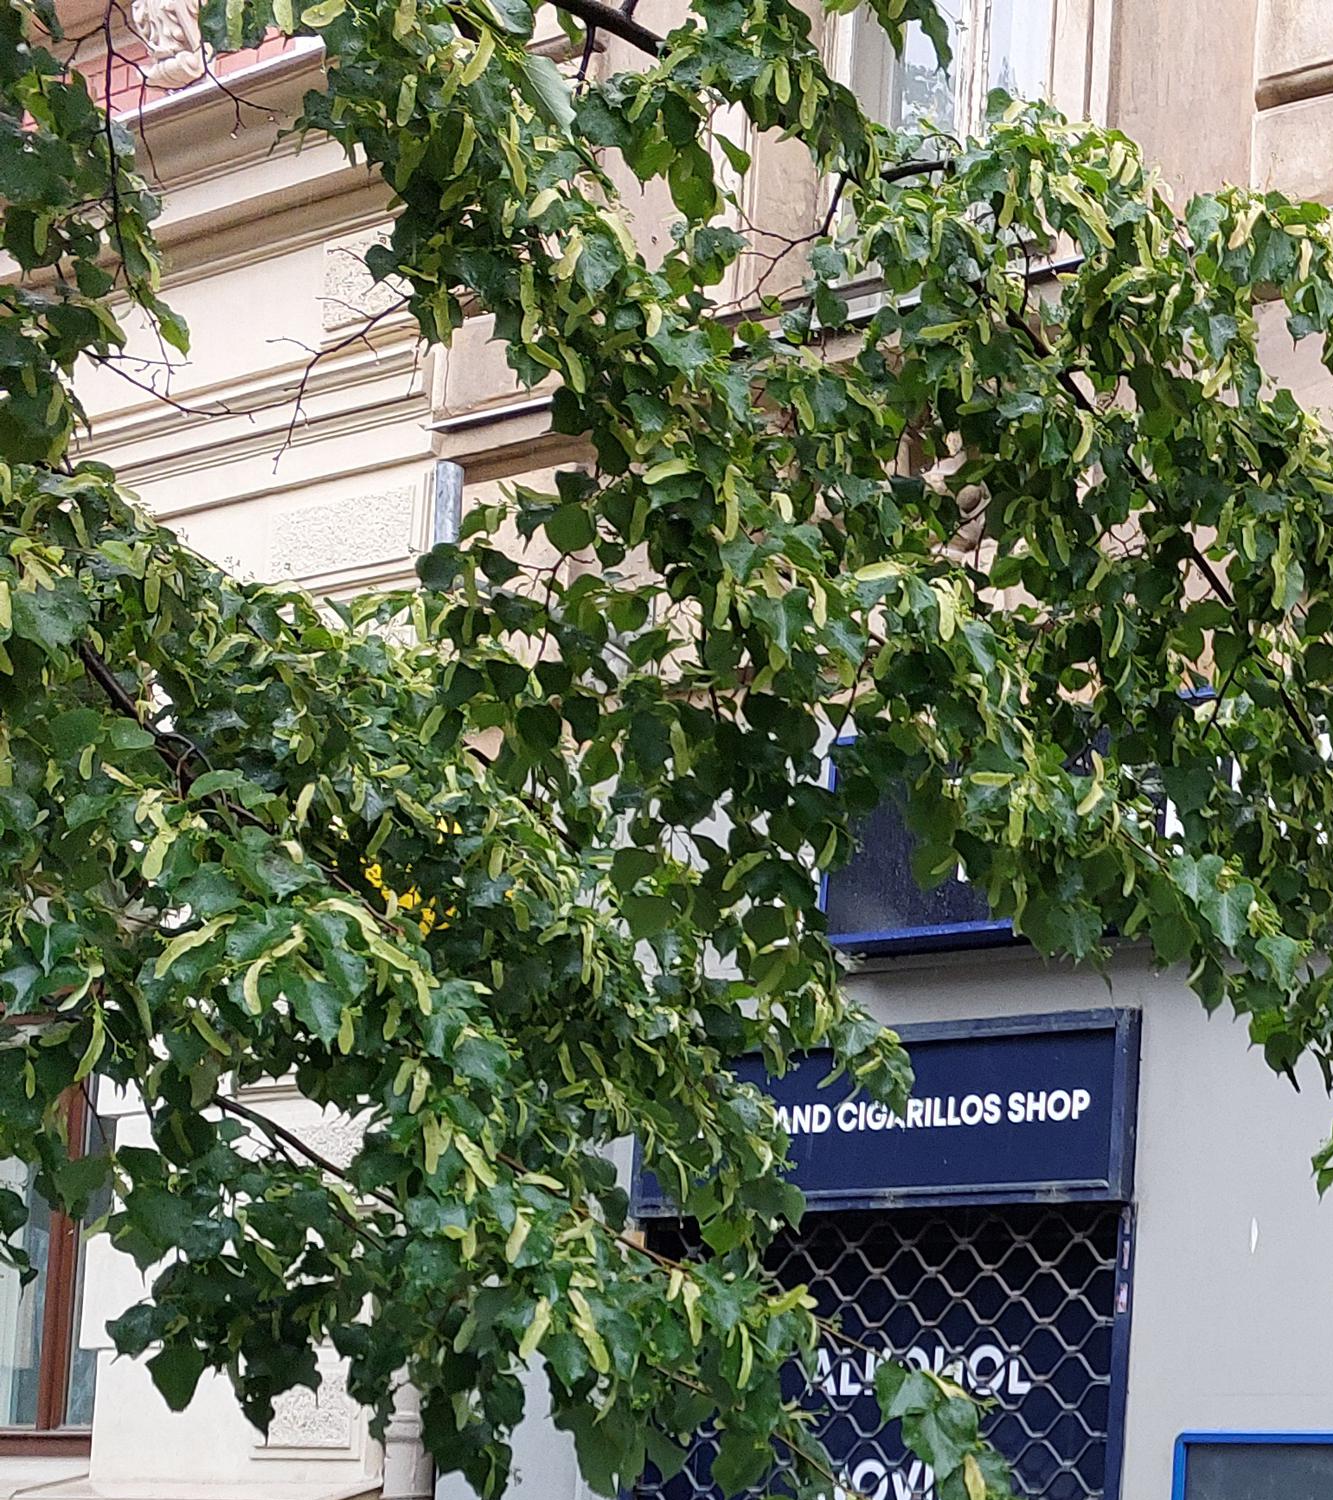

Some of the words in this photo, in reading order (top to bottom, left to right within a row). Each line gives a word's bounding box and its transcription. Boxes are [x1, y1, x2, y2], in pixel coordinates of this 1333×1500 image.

[778, 1103, 832, 1135] AND
[836, 1093, 1002, 1132] CIGARILLOS
[1006, 1088, 1091, 1123] SHOP
